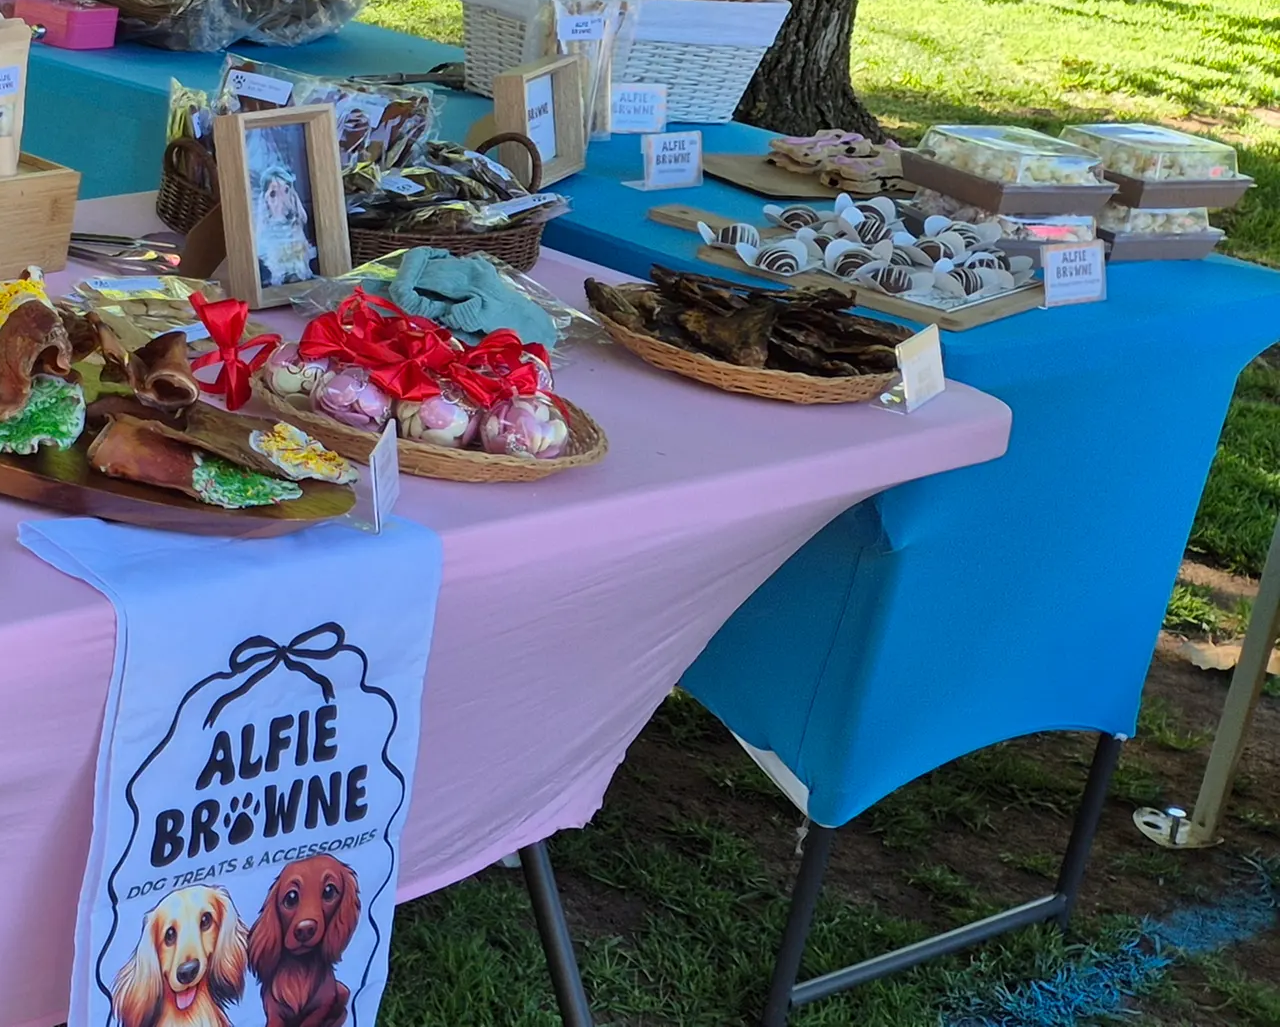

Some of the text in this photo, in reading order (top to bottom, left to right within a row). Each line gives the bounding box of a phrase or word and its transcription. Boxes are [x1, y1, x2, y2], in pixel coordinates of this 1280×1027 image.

[620, 92, 648, 103] ALFIE
[661, 139, 686, 152] ALFIE
[1061, 249, 1087, 264] ALFIE
[195, 704, 338, 791] ALFIE
[150, 764, 368, 868] BROWNE
[126, 828, 378, 900] DOG TREATS & ACCESSORIES
